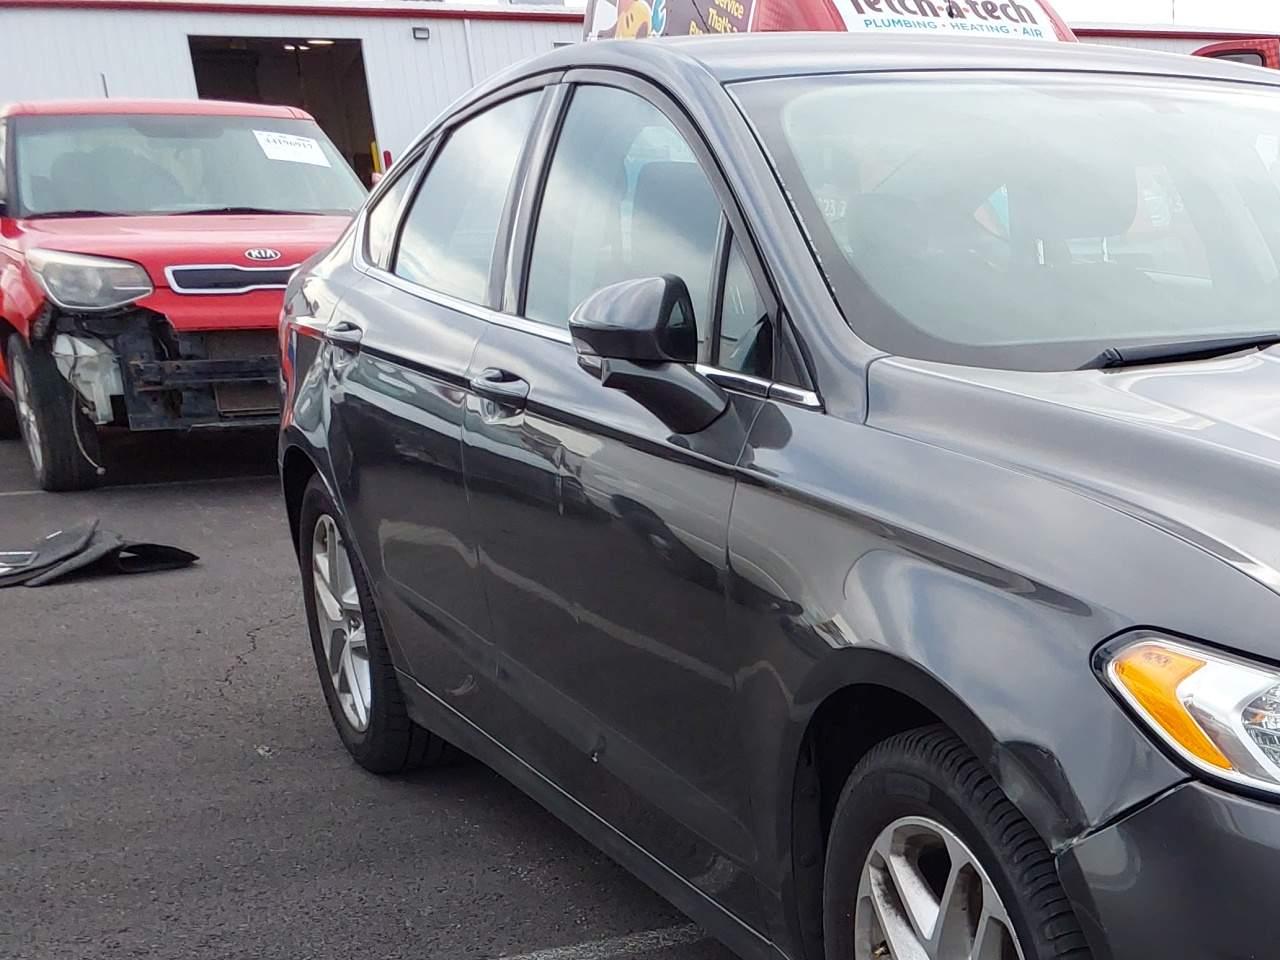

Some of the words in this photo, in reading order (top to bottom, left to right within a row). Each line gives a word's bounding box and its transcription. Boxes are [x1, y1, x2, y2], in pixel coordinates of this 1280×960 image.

[864, 18, 938, 30] PLUMBING
[950, 22, 1010, 34] HEATING
[1022, 27, 1044, 39] AIR
[250, 249, 276, 258] KIA
